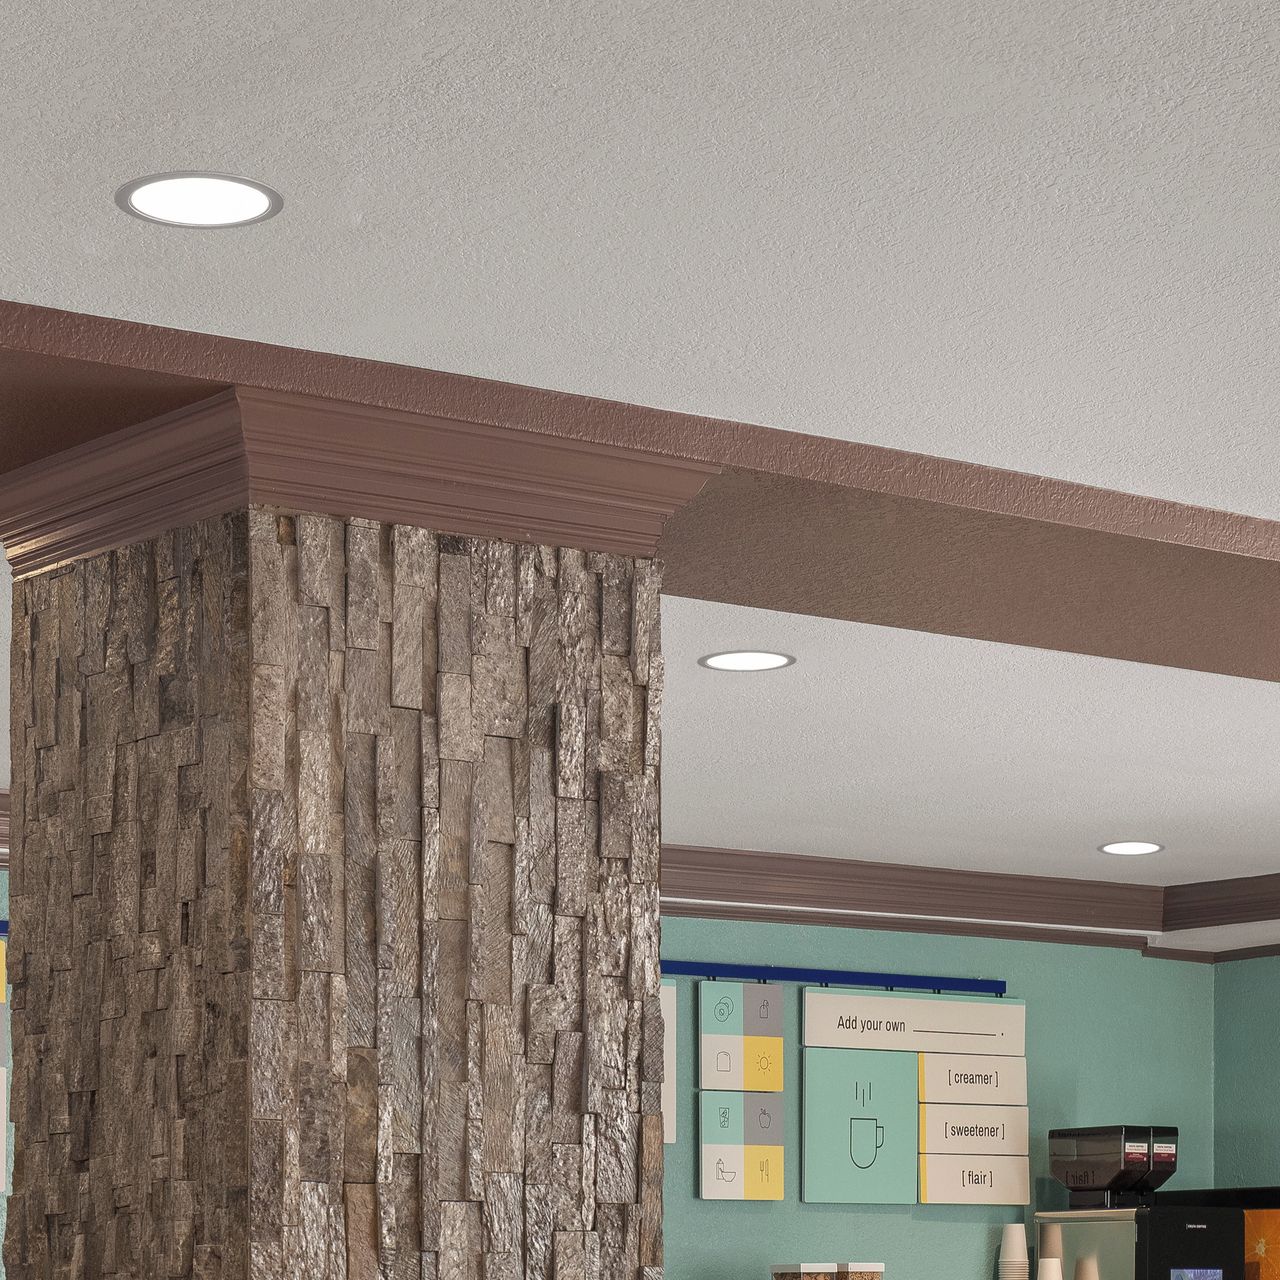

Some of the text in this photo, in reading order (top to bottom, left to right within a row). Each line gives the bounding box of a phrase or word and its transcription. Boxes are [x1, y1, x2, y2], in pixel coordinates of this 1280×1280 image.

[836, 1015, 906, 1033] Add your own
[954, 1072, 993, 1085] creamer
[950, 1123, 1000, 1138] sweetener
[967, 1170, 987, 1185] flair
